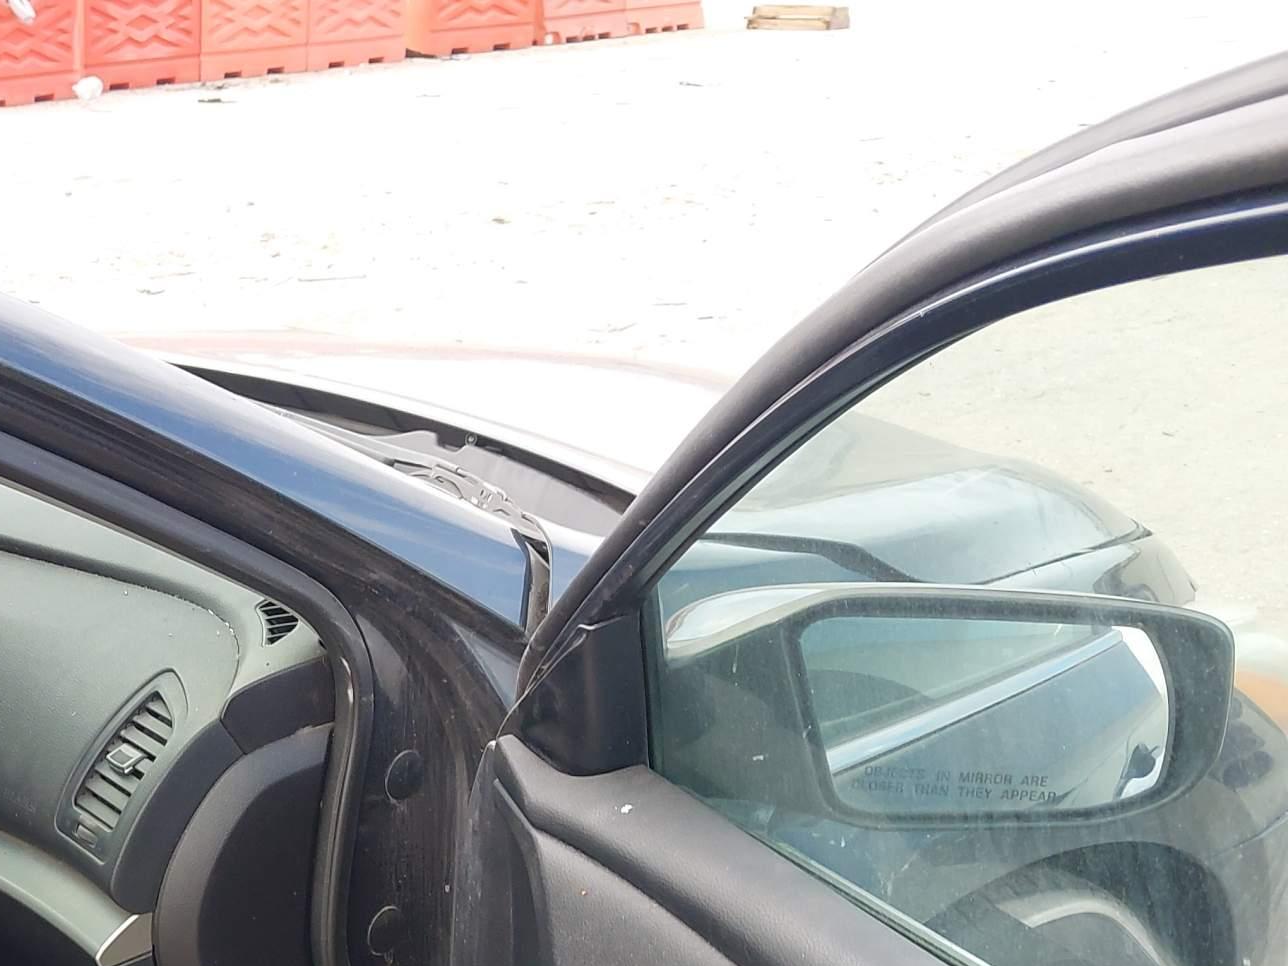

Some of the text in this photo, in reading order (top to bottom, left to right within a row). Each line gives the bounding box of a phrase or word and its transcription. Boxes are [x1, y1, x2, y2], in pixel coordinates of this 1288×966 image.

[864, 766, 1049, 787] OBJECTS IN MIRROR ARE
[851, 778, 1057, 803] CLOSER THAN THEY APPEAR
